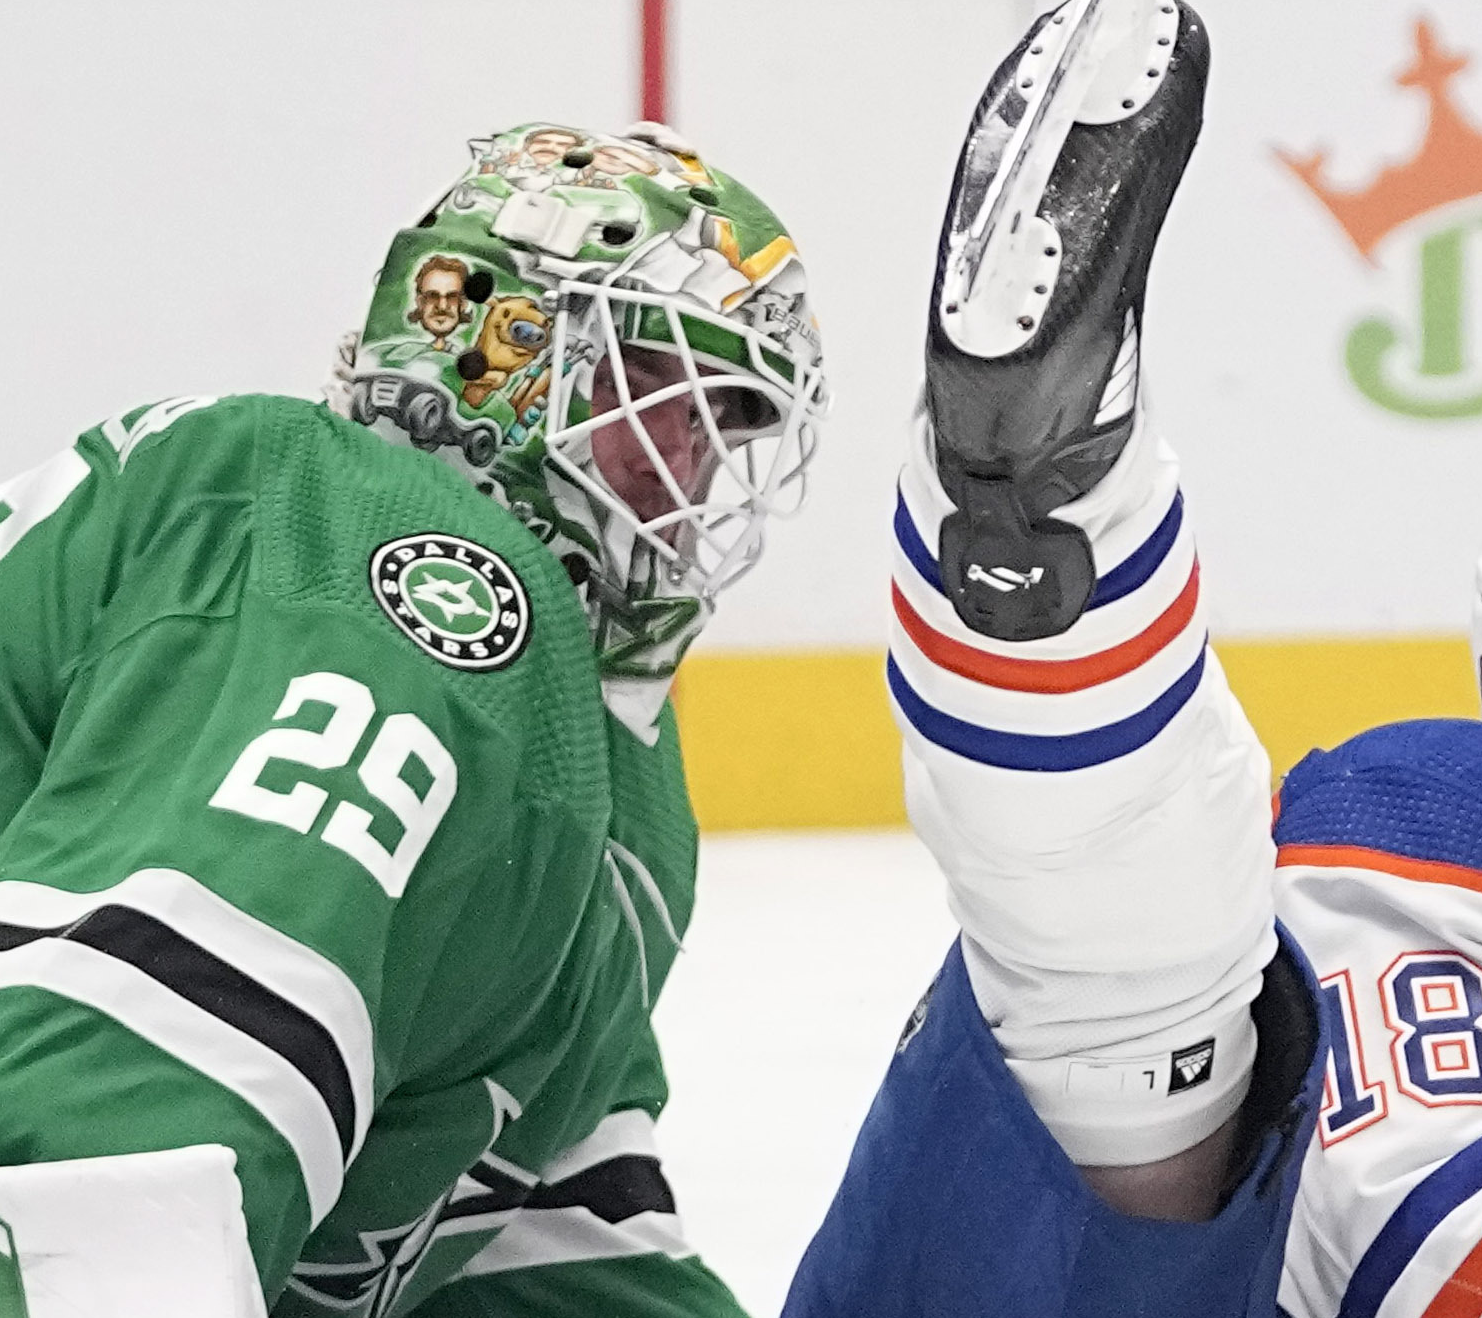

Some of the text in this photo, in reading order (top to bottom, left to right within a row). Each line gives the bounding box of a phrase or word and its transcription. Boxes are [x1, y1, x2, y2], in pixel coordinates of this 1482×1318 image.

[380, 541, 519, 658] DALLAS STARS
[208, 672, 458, 898] 29
